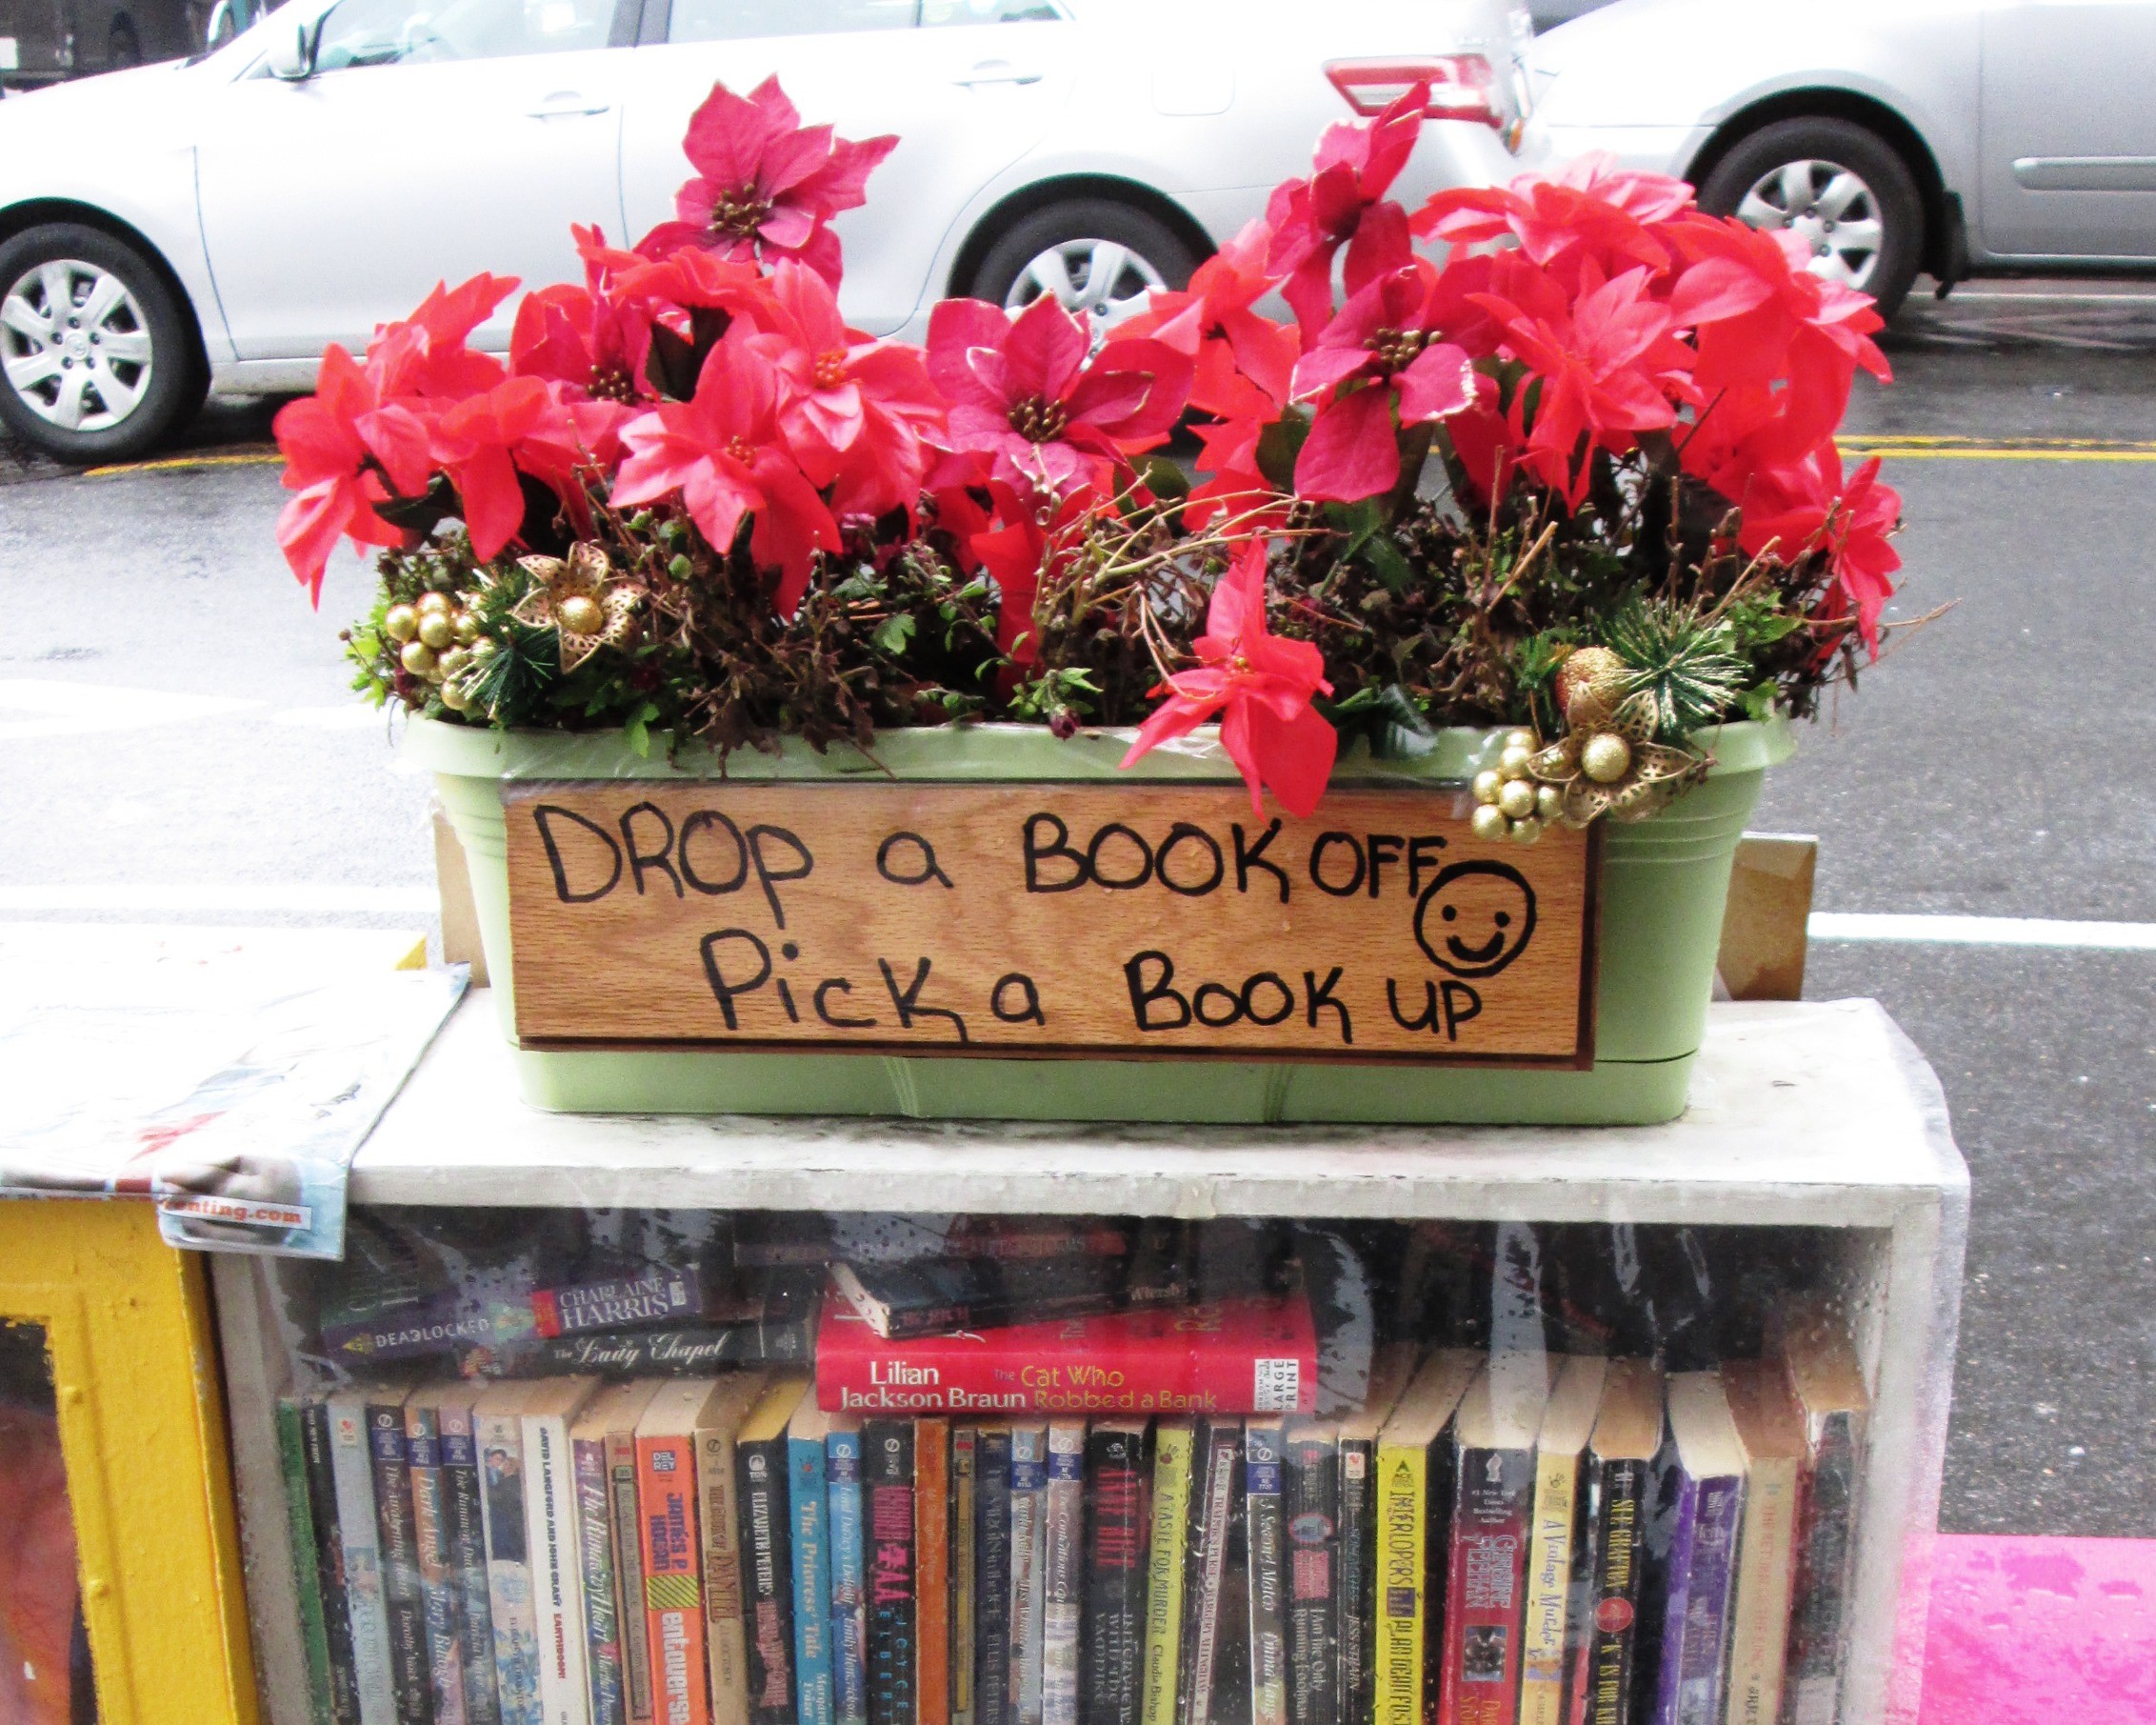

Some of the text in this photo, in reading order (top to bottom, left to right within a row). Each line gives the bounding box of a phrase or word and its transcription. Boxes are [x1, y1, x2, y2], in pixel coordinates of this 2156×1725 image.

[534, 802, 1447, 930] DROP a BOOK OFF
[991, 972, 1043, 1027] a
[560, 1277, 665, 1308] CHARLAINE
[562, 1293, 669, 1330] HARRIS
[374, 1318, 489, 1350] DEADLOCKED
[573, 1336, 638, 1366] Lady
[649, 1331, 727, 1365] Chapel
[870, 1361, 940, 1386] Lilian
[994, 1366, 1126, 1387] The Cat Who
[1273, 1360, 1285, 1410] LARGE
[840, 1388, 1026, 1410] Jackson Braun
[1034, 1390, 1217, 1409] Robbed a Bank
[653, 1451, 675, 1460] DEL
[653, 1461, 675, 1471] REY
[418, 1476, 437, 1517] Dark
[583, 1485, 607, 1516] The
[1162, 1494, 1173, 1502] A
[540, 1428, 563, 1607] DAVID LANGFORD AND JOHN GRANT
[751, 1492, 772, 1551] ELIZABETH
[800, 1501, 818, 1536] The
[1157, 1504, 1174, 1546] TASTE
[418, 1518, 440, 1568] Angel
[649, 1515, 670, 1571] HOGAN
[1260, 1514, 1277, 1565] Second
[1387, 1491, 1416, 1587] INTERLOPERS
[1606, 1499, 1634, 1588] SUE GRAFTON
[755, 1553, 774, 1595] PETERS
[1154, 1549, 1170, 1575] FOR
[1538, 1519, 1567, 1646] A Vintage Murder
[1151, 1578, 1170, 1635] MURDER
[1311, 1615, 1327, 1635] Am
[804, 1623, 822, 1659] Tale
[840, 1617, 856, 1651] Emily
[988, 1633, 1002, 1671] ELLIS
[1148, 1644, 1164, 1722] Claudia Bishop
[1308, 1660, 1328, 1693] Only
[987, 1675, 1001, 1725] PETERS
